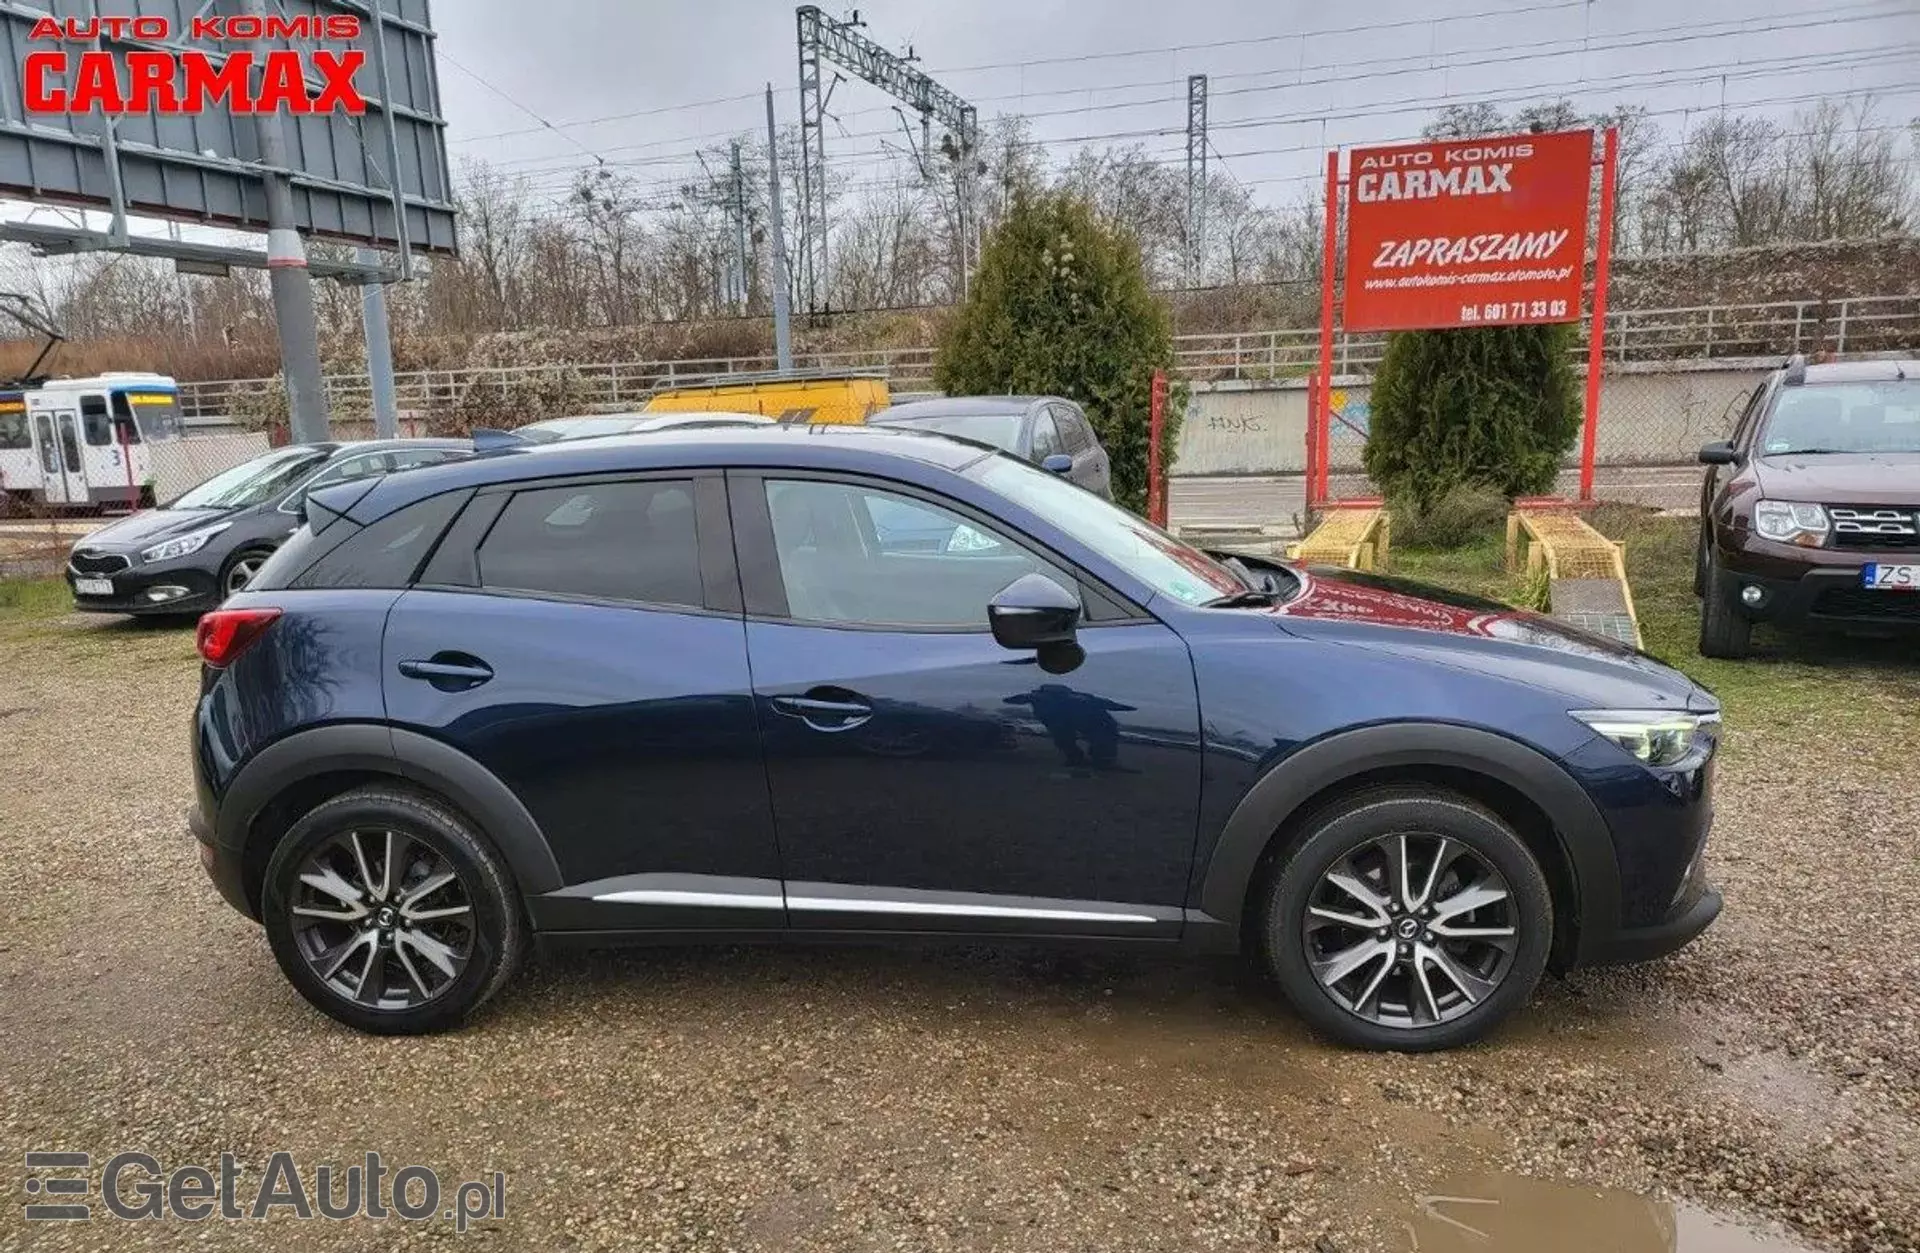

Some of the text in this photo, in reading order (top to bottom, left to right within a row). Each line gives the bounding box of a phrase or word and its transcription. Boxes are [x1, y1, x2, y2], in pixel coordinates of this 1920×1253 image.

[1360, 144, 1535, 169] AUTO KOMIS
[1357, 163, 1514, 203] CARMAX
[1372, 228, 1569, 269] ZAPRASZAMY
[1365, 265, 1573, 290] www.autokomis-carmax.otomoto.pl
[1461, 299, 1567, 322] tel. 601 71 33 03
[1880, 566, 1912, 584] ZS
